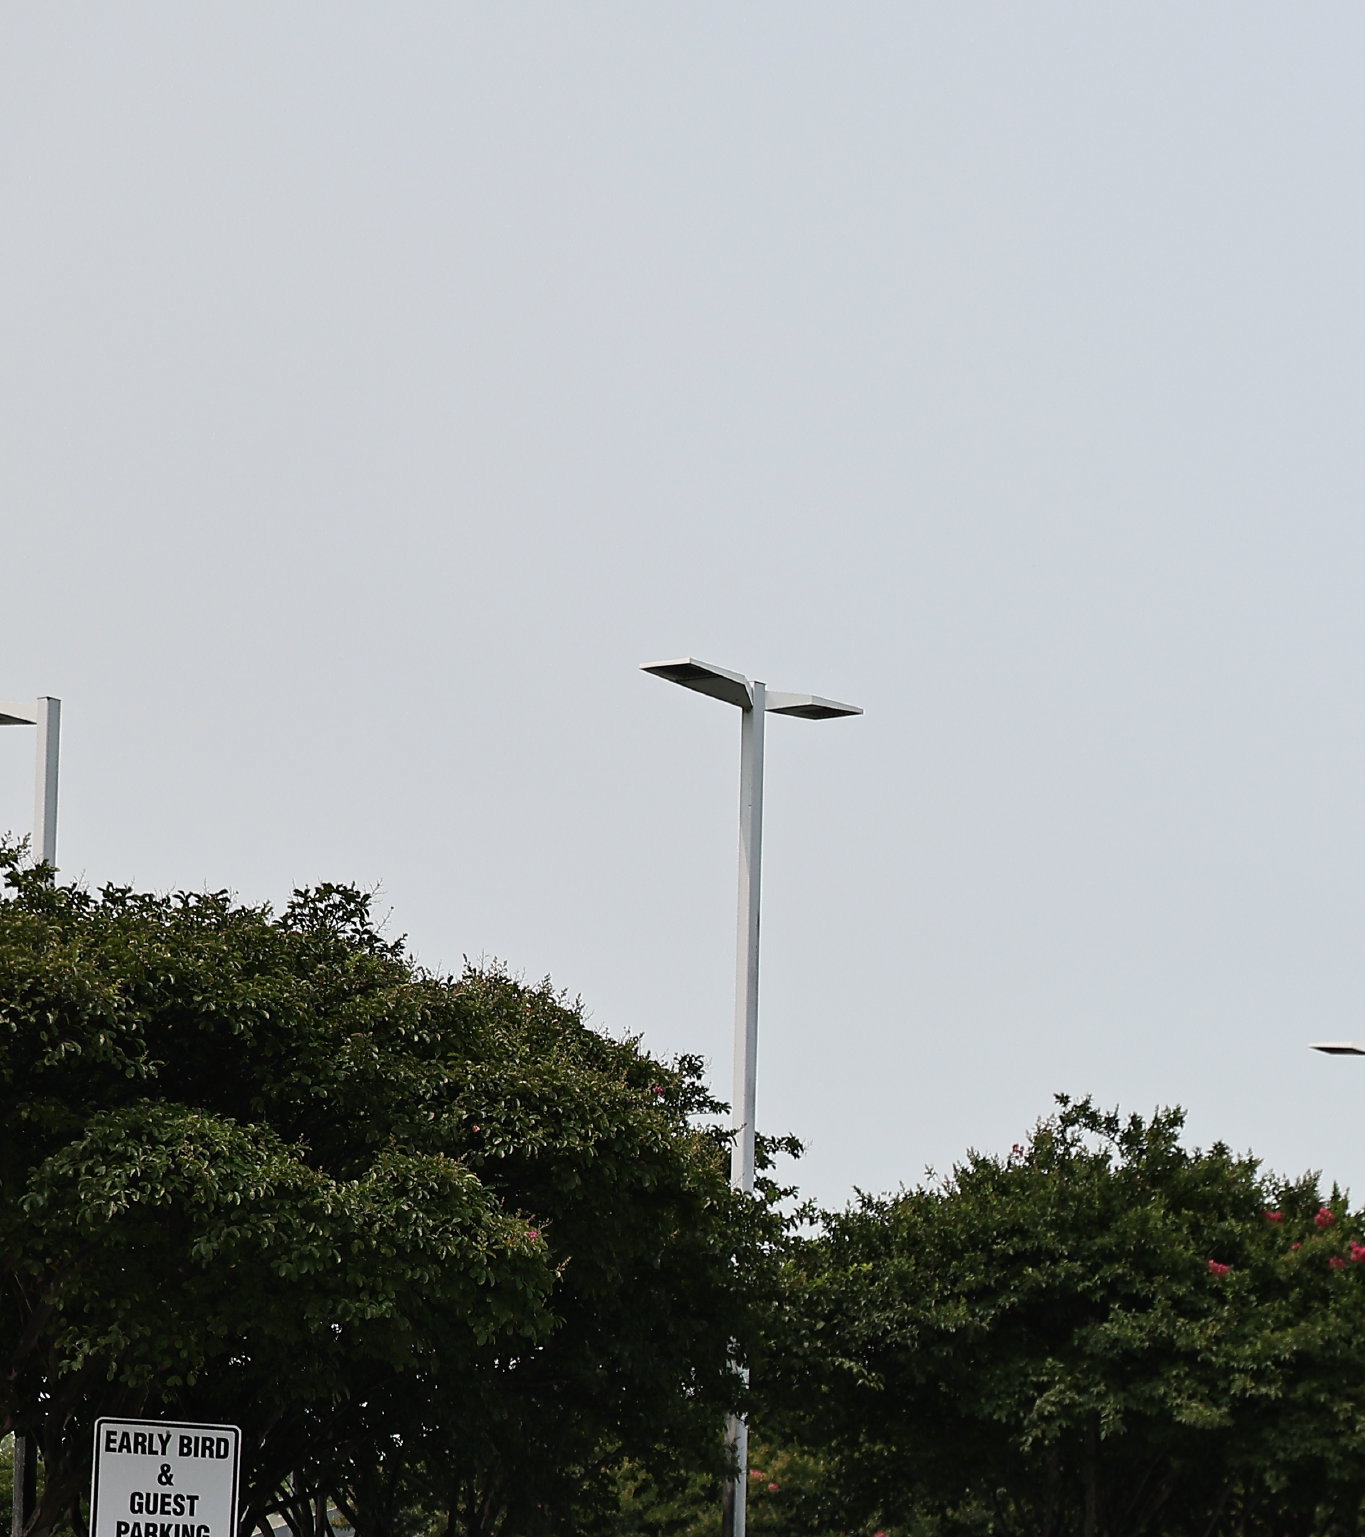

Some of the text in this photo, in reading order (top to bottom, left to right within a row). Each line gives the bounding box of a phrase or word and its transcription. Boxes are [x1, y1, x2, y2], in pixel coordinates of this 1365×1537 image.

[105, 1430, 230, 1459] EARLY BIRD
[157, 1463, 174, 1486] &
[129, 1491, 199, 1517] GUEST
